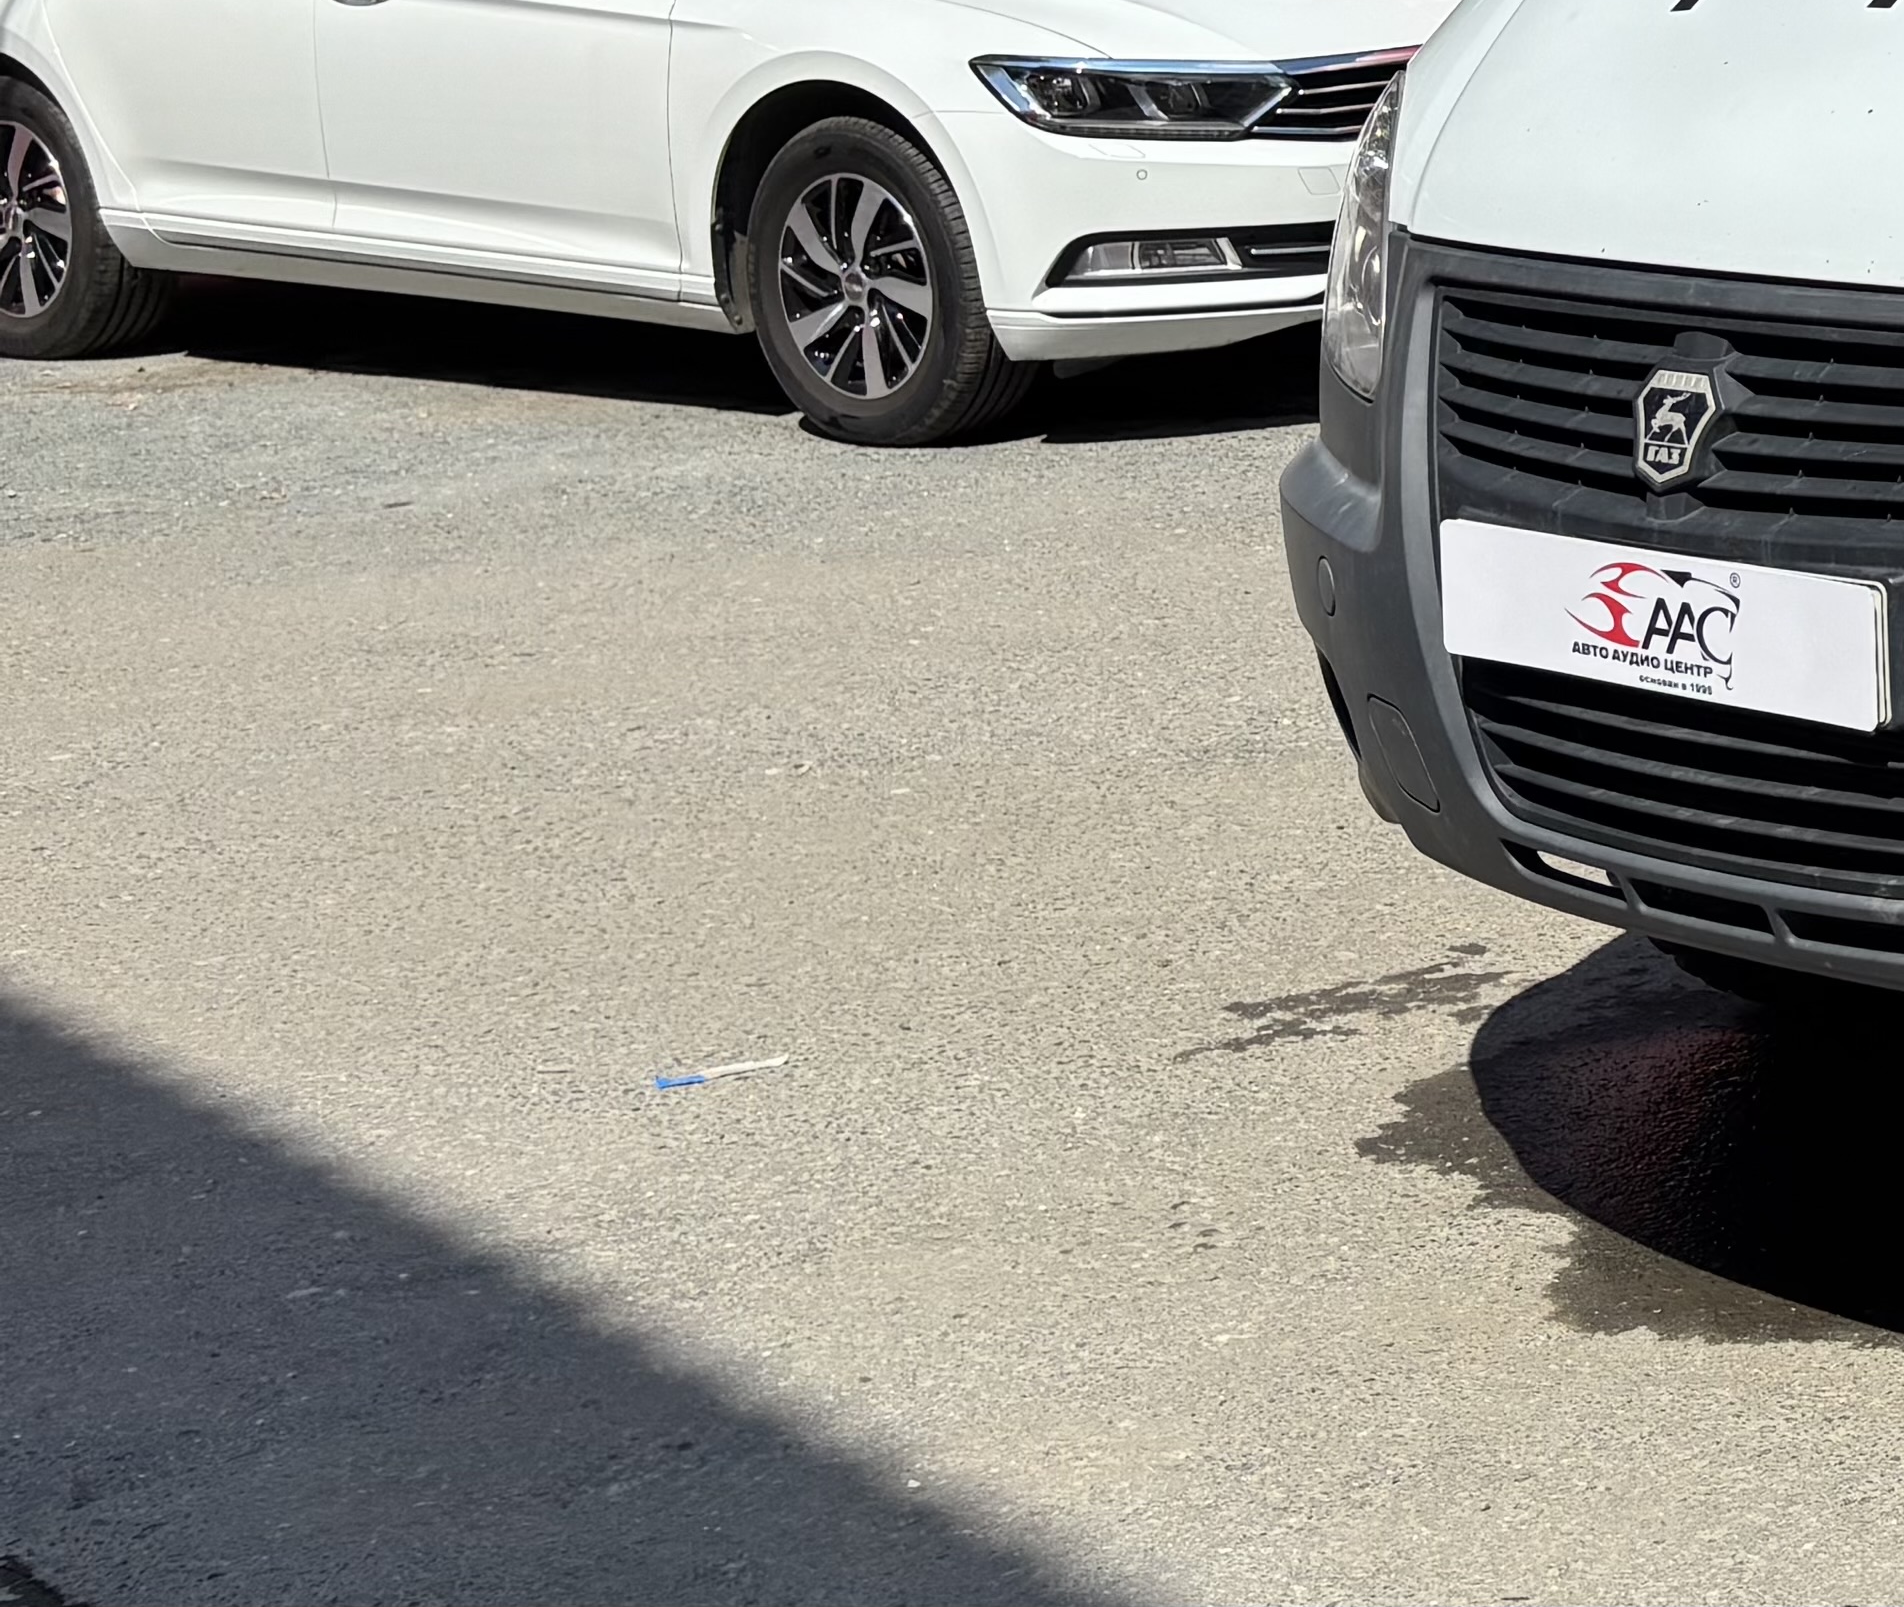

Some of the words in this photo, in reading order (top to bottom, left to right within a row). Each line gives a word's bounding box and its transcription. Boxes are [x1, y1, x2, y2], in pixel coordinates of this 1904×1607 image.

[1646, 445, 1682, 465] ГАЗ
[1572, 641, 1609, 659] АВТО
[1612, 649, 1661, 669] АУДИО
[1664, 659, 1713, 678] ЦЕНТР
